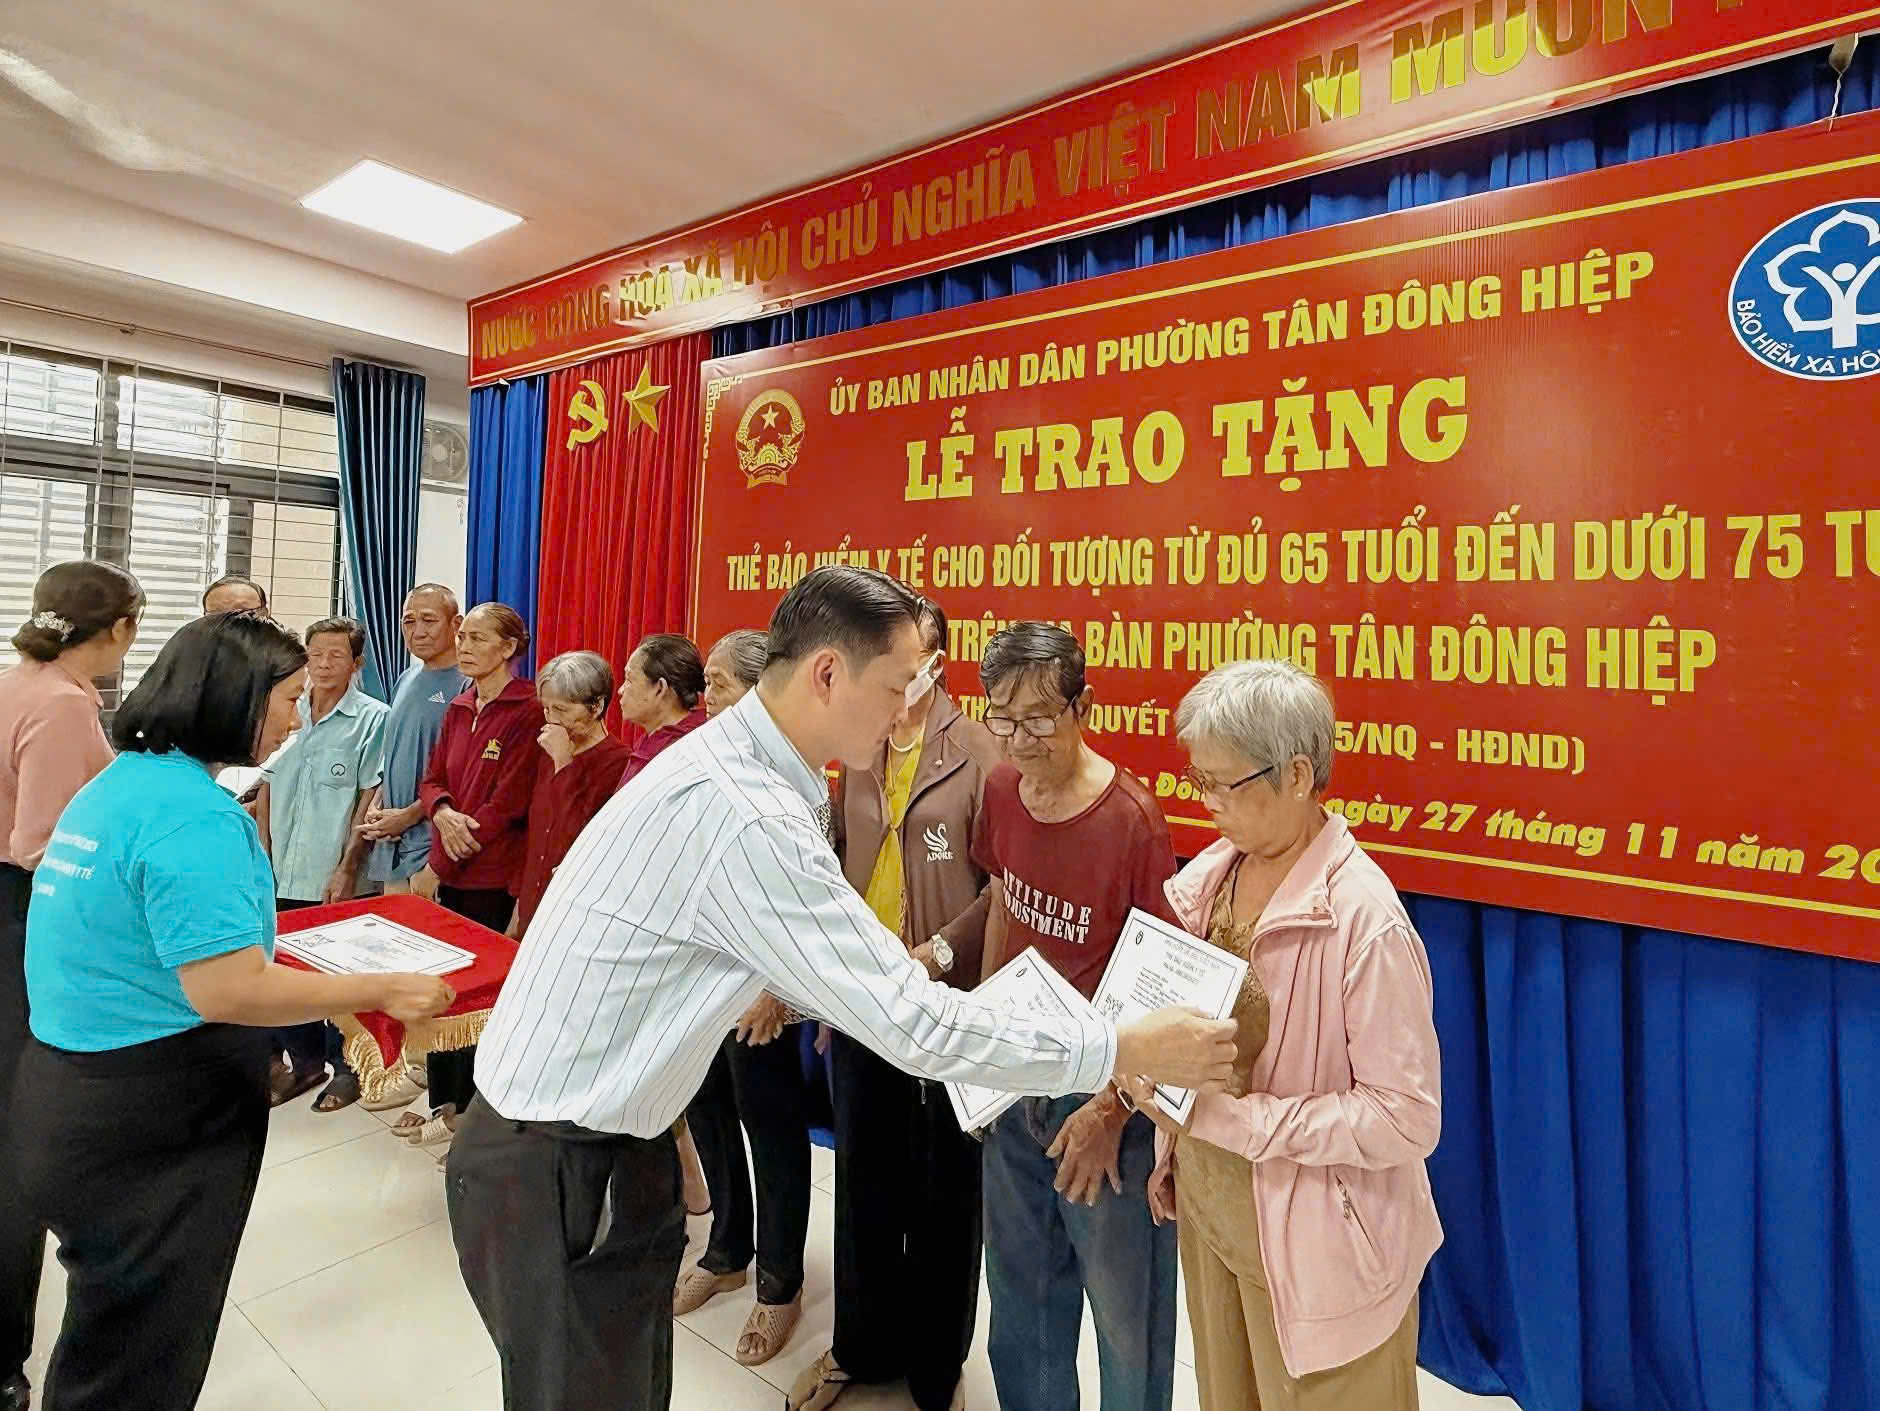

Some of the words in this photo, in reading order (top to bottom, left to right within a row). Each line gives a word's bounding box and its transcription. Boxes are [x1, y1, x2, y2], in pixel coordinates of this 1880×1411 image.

[801, 181, 878, 271] CHỦ
[892, 144, 1036, 246] NGHĨA
[1054, 98, 1176, 198] VIỆT
[1194, 43, 1361, 159] NAM
[831, 377, 860, 415] ỦY
[868, 373, 920, 409] BAN
[929, 356, 1009, 400] NHÂN
[1020, 343, 1085, 386] DÂN
[1097, 317, 1249, 375] PHƯỜNG
[1263, 299, 1347, 349] TÂN
[1362, 276, 1501, 335] ĐÔNG
[1522, 248, 1653, 313] HIỆP
[1736, 299, 1762, 335] BẢO
[1751, 332, 1801, 369] HIỂM
[1801, 355, 1836, 374] XÃ
[905, 406, 974, 501] LỄ
[995, 411, 1184, 493] TRAO
[1213, 376, 1468, 491] TẶNG
[728, 544, 761, 590] THẺ
[767, 540, 808, 589] BẢO
[897, 533, 928, 588] TẾ
[933, 545, 984, 587] CHO
[993, 528, 1040, 587] ĐỐI
[1050, 535, 1153, 596] TƯỢNG
[1164, 526, 1211, 584] TỪ
[1217, 516, 1267, 584] ĐỦ
[1280, 536, 1328, 585] 65
[1342, 505, 1438, 583] TUỔI
[1454, 504, 1554, 581] ĐẾN
[1574, 504, 1705, 580] DƯỚI
[1727, 514, 1803, 579] 75
[948, 610, 1008, 662] TRÊ
[1085, 611, 1152, 668] BÀN
[1163, 608, 1316, 678] PHƯỜNG
[1330, 613, 1414, 680] TÂN
[1429, 614, 1566, 686] ĐÔNG
[1587, 616, 1716, 705] HIỆP
[1089, 698, 1169, 736] QUYẾT
[1458, 729, 1584, 774] HĐND)
[1322, 792, 1413, 831] ngày
[1420, 801, 1477, 832] 27
[1486, 810, 1606, 856] tháng
[1696, 834, 1804, 873] năm
[1817, 844, 1880, 884] 20
